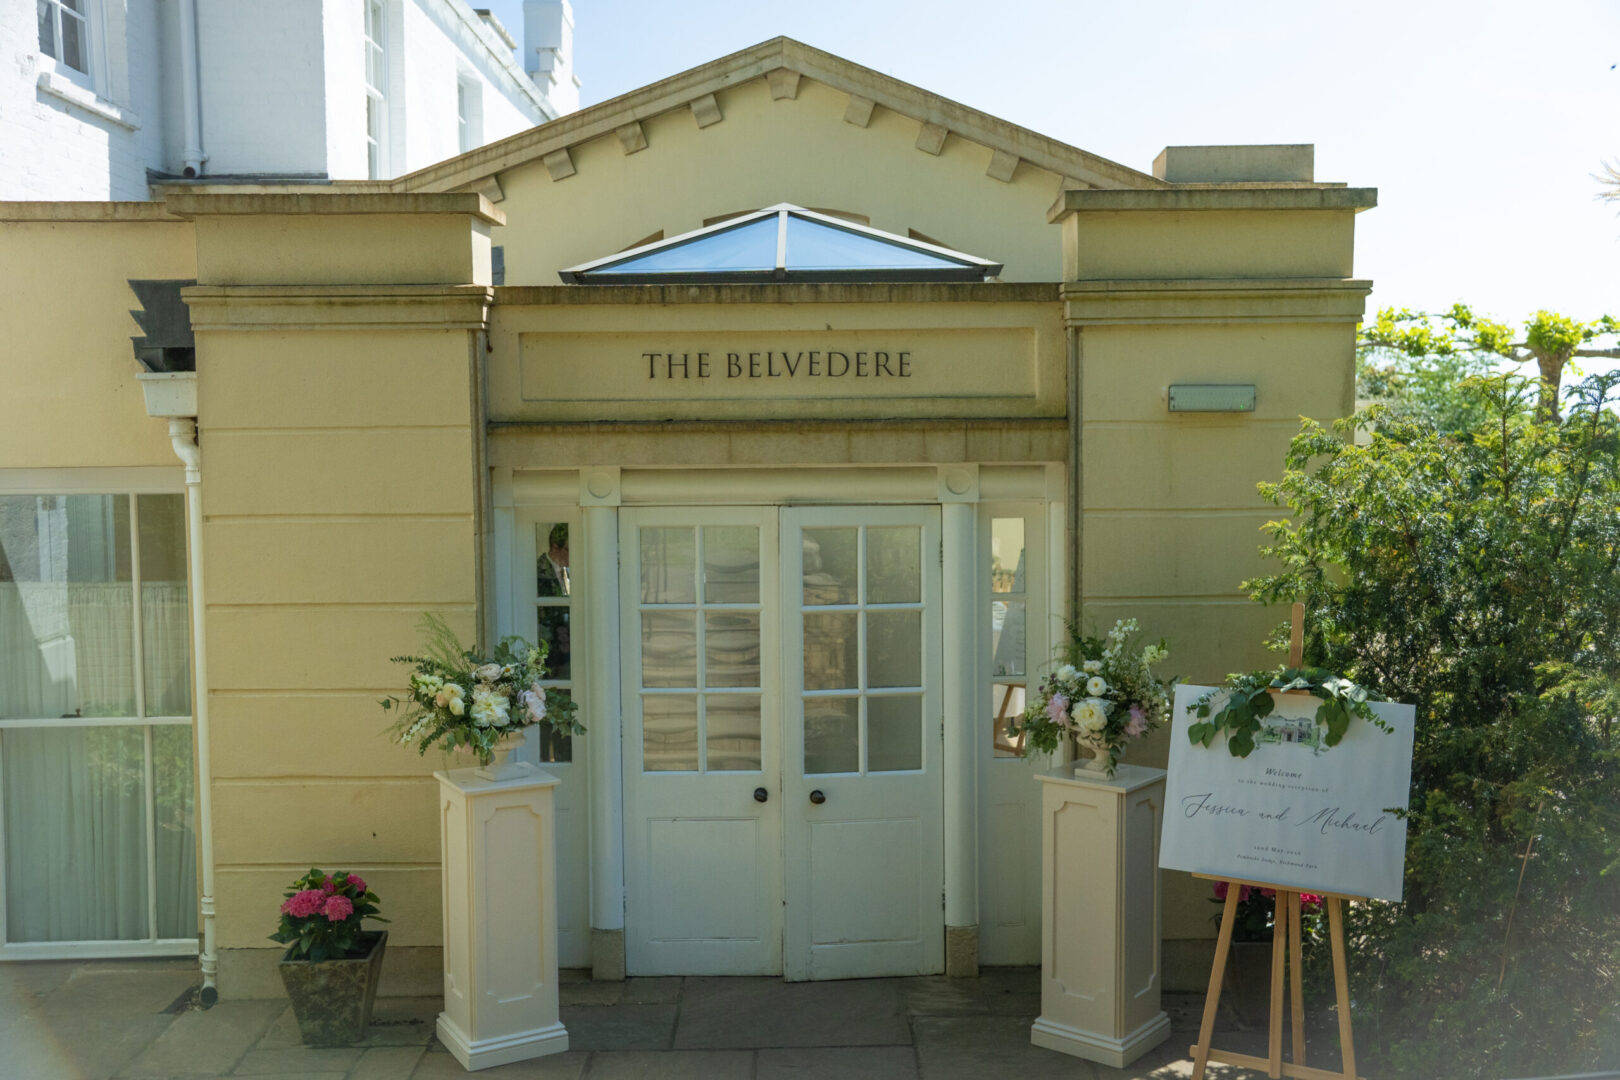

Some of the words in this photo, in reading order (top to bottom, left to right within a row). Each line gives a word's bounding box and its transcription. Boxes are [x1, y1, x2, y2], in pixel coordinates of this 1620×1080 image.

[641, 352, 711, 379] THE
[726, 351, 912, 378] BELVEDERE
[1265, 767, 1302, 779] Welcome
[1259, 781, 1286, 789] wedding
[1288, 784, 1319, 792] reception
[1181, 792, 1250, 818] Jessica
[1258, 807, 1291, 822] and
[1295, 807, 1386, 835] Michael
